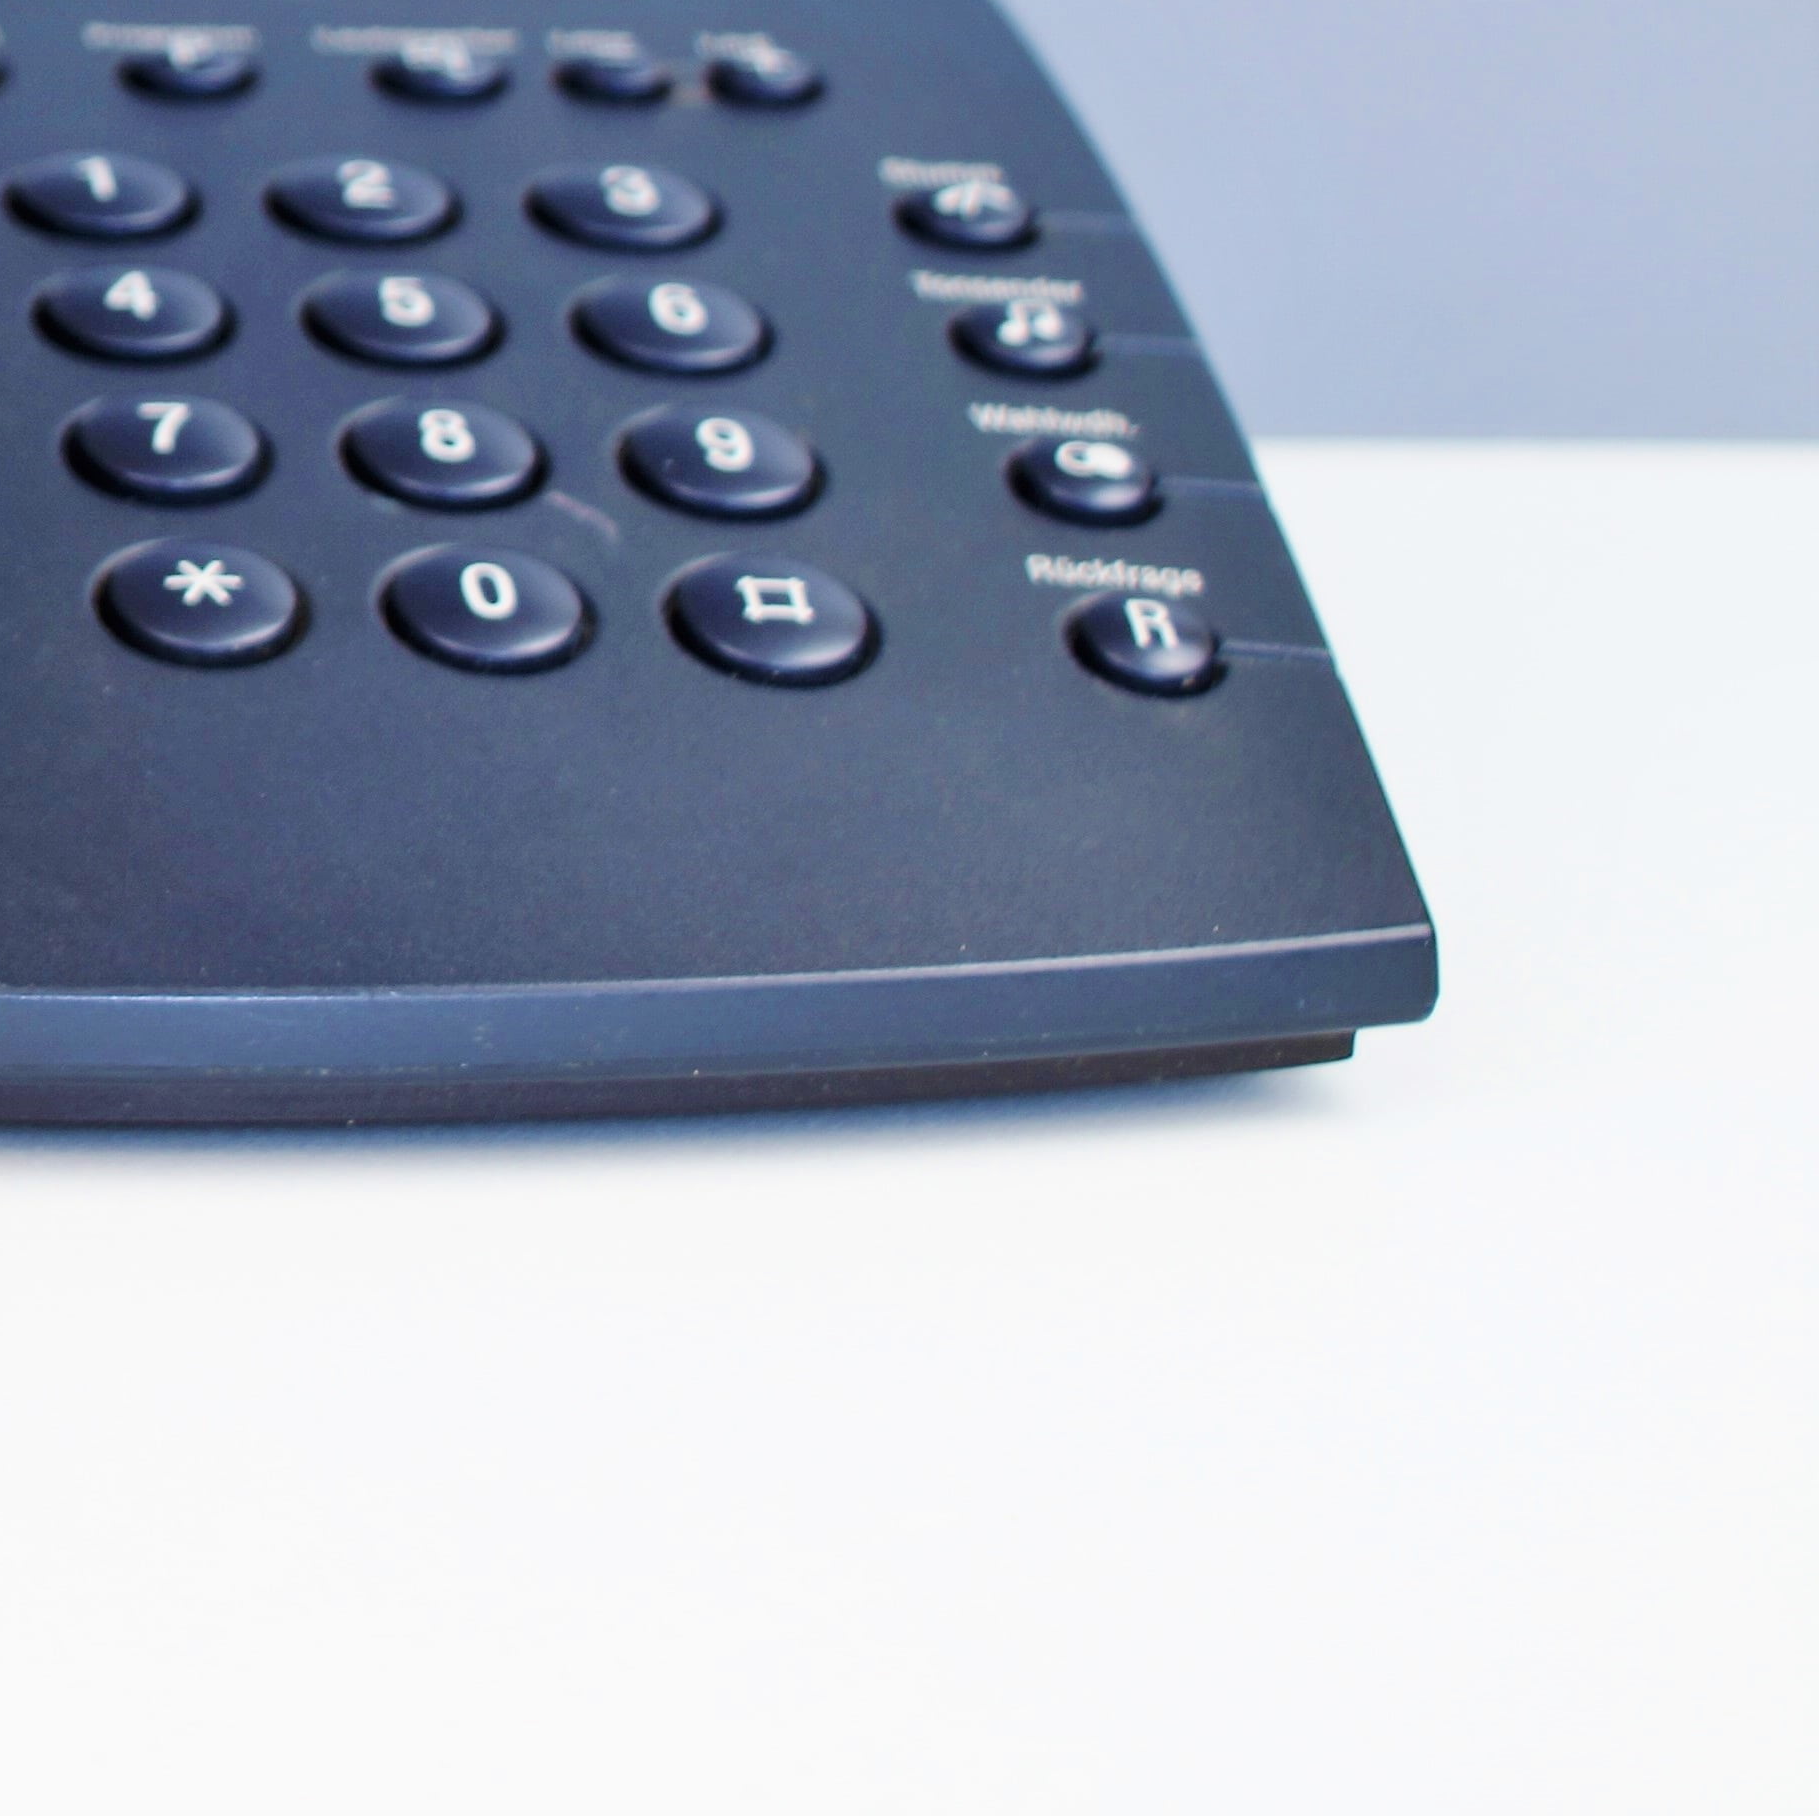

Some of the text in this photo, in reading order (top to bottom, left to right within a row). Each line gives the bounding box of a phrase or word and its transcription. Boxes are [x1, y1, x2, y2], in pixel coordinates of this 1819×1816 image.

[74, 153, 117, 200] 1
[336, 157, 394, 208] 2
[599, 164, 660, 217] 3
[105, 270, 157, 319] 4
[378, 274, 436, 327] 5
[649, 281, 709, 335] 6
[138, 400, 192, 454] 7
[418, 407, 477, 463] 8
[695, 415, 756, 473] 9
[459, 561, 519, 621] 0
[1025, 553, 1203, 598] Rückfrage
[1124, 598, 1178, 649] R
